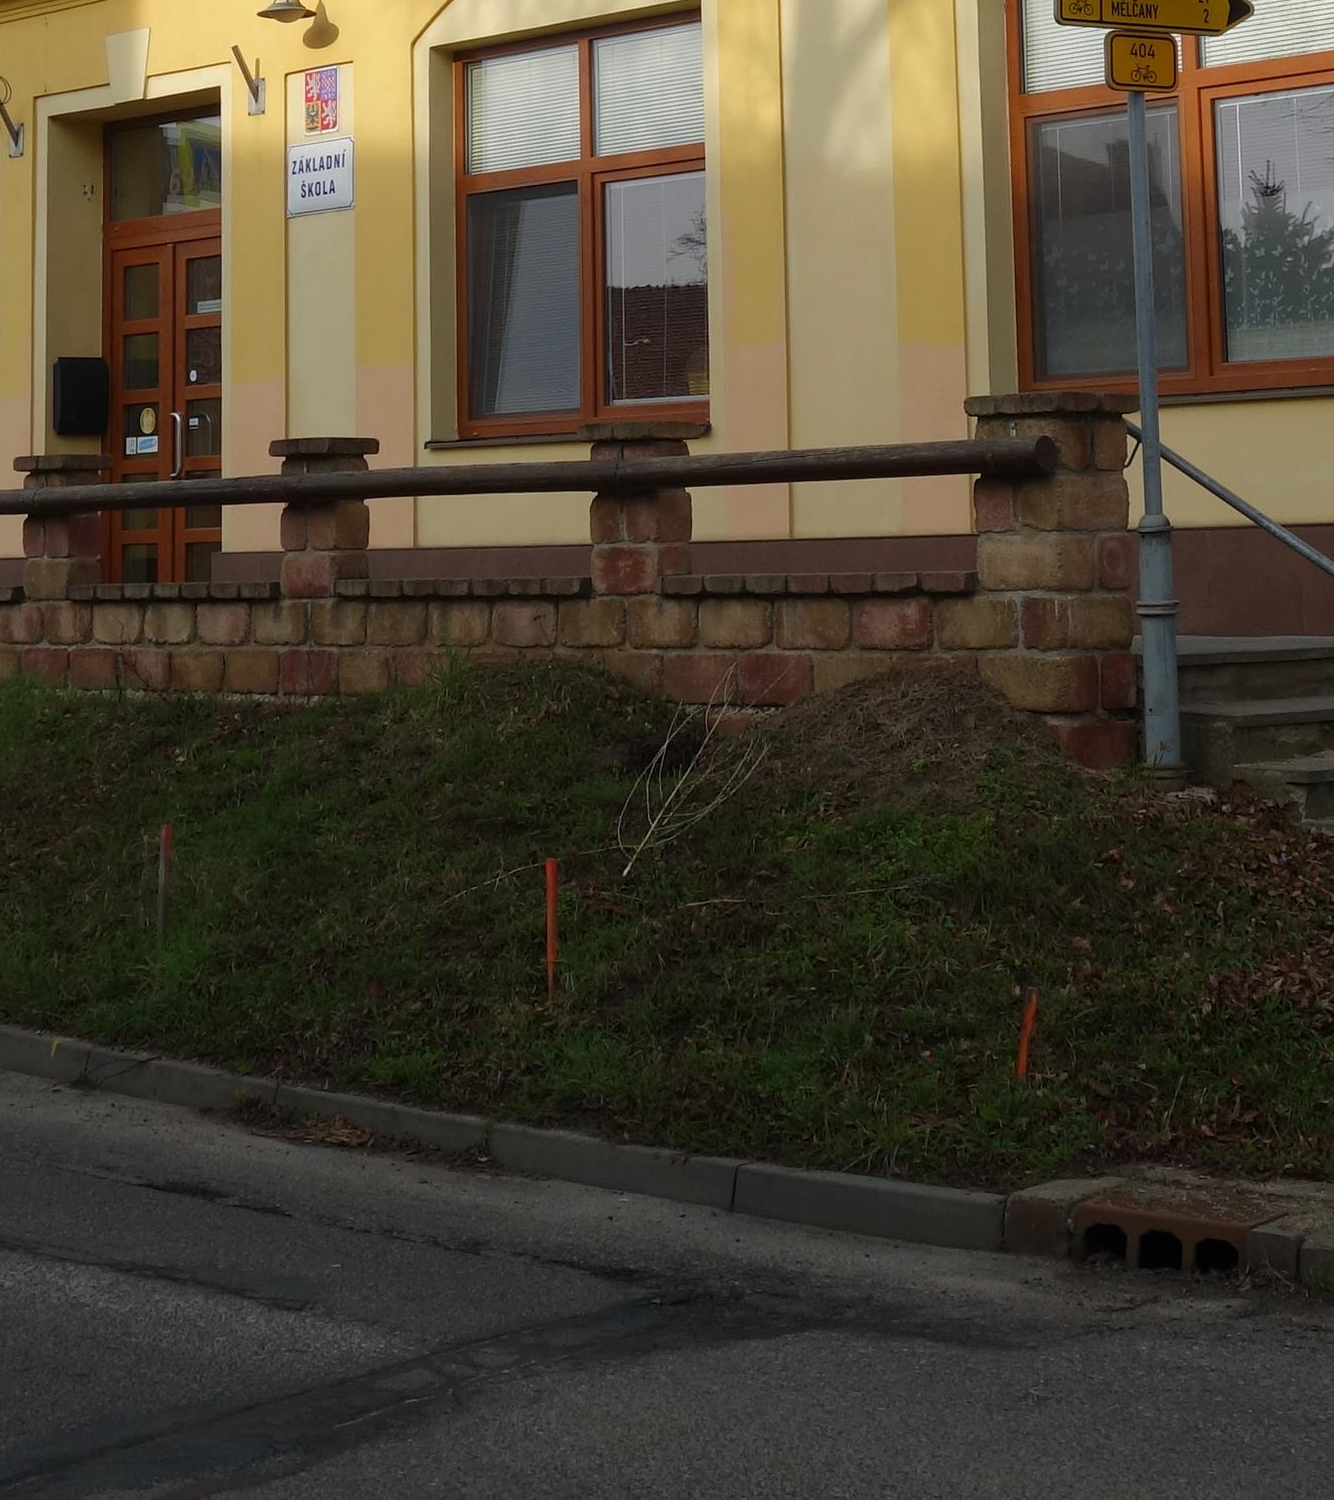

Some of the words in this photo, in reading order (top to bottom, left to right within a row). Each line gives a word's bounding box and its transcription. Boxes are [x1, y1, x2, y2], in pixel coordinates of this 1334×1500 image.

[1203, 8, 1210, 24] 2
[1130, 43, 1156, 60] 404
[291, 149, 347, 176] ZÁKLADNÍ
[300, 179, 336, 199] ŠKOLA
